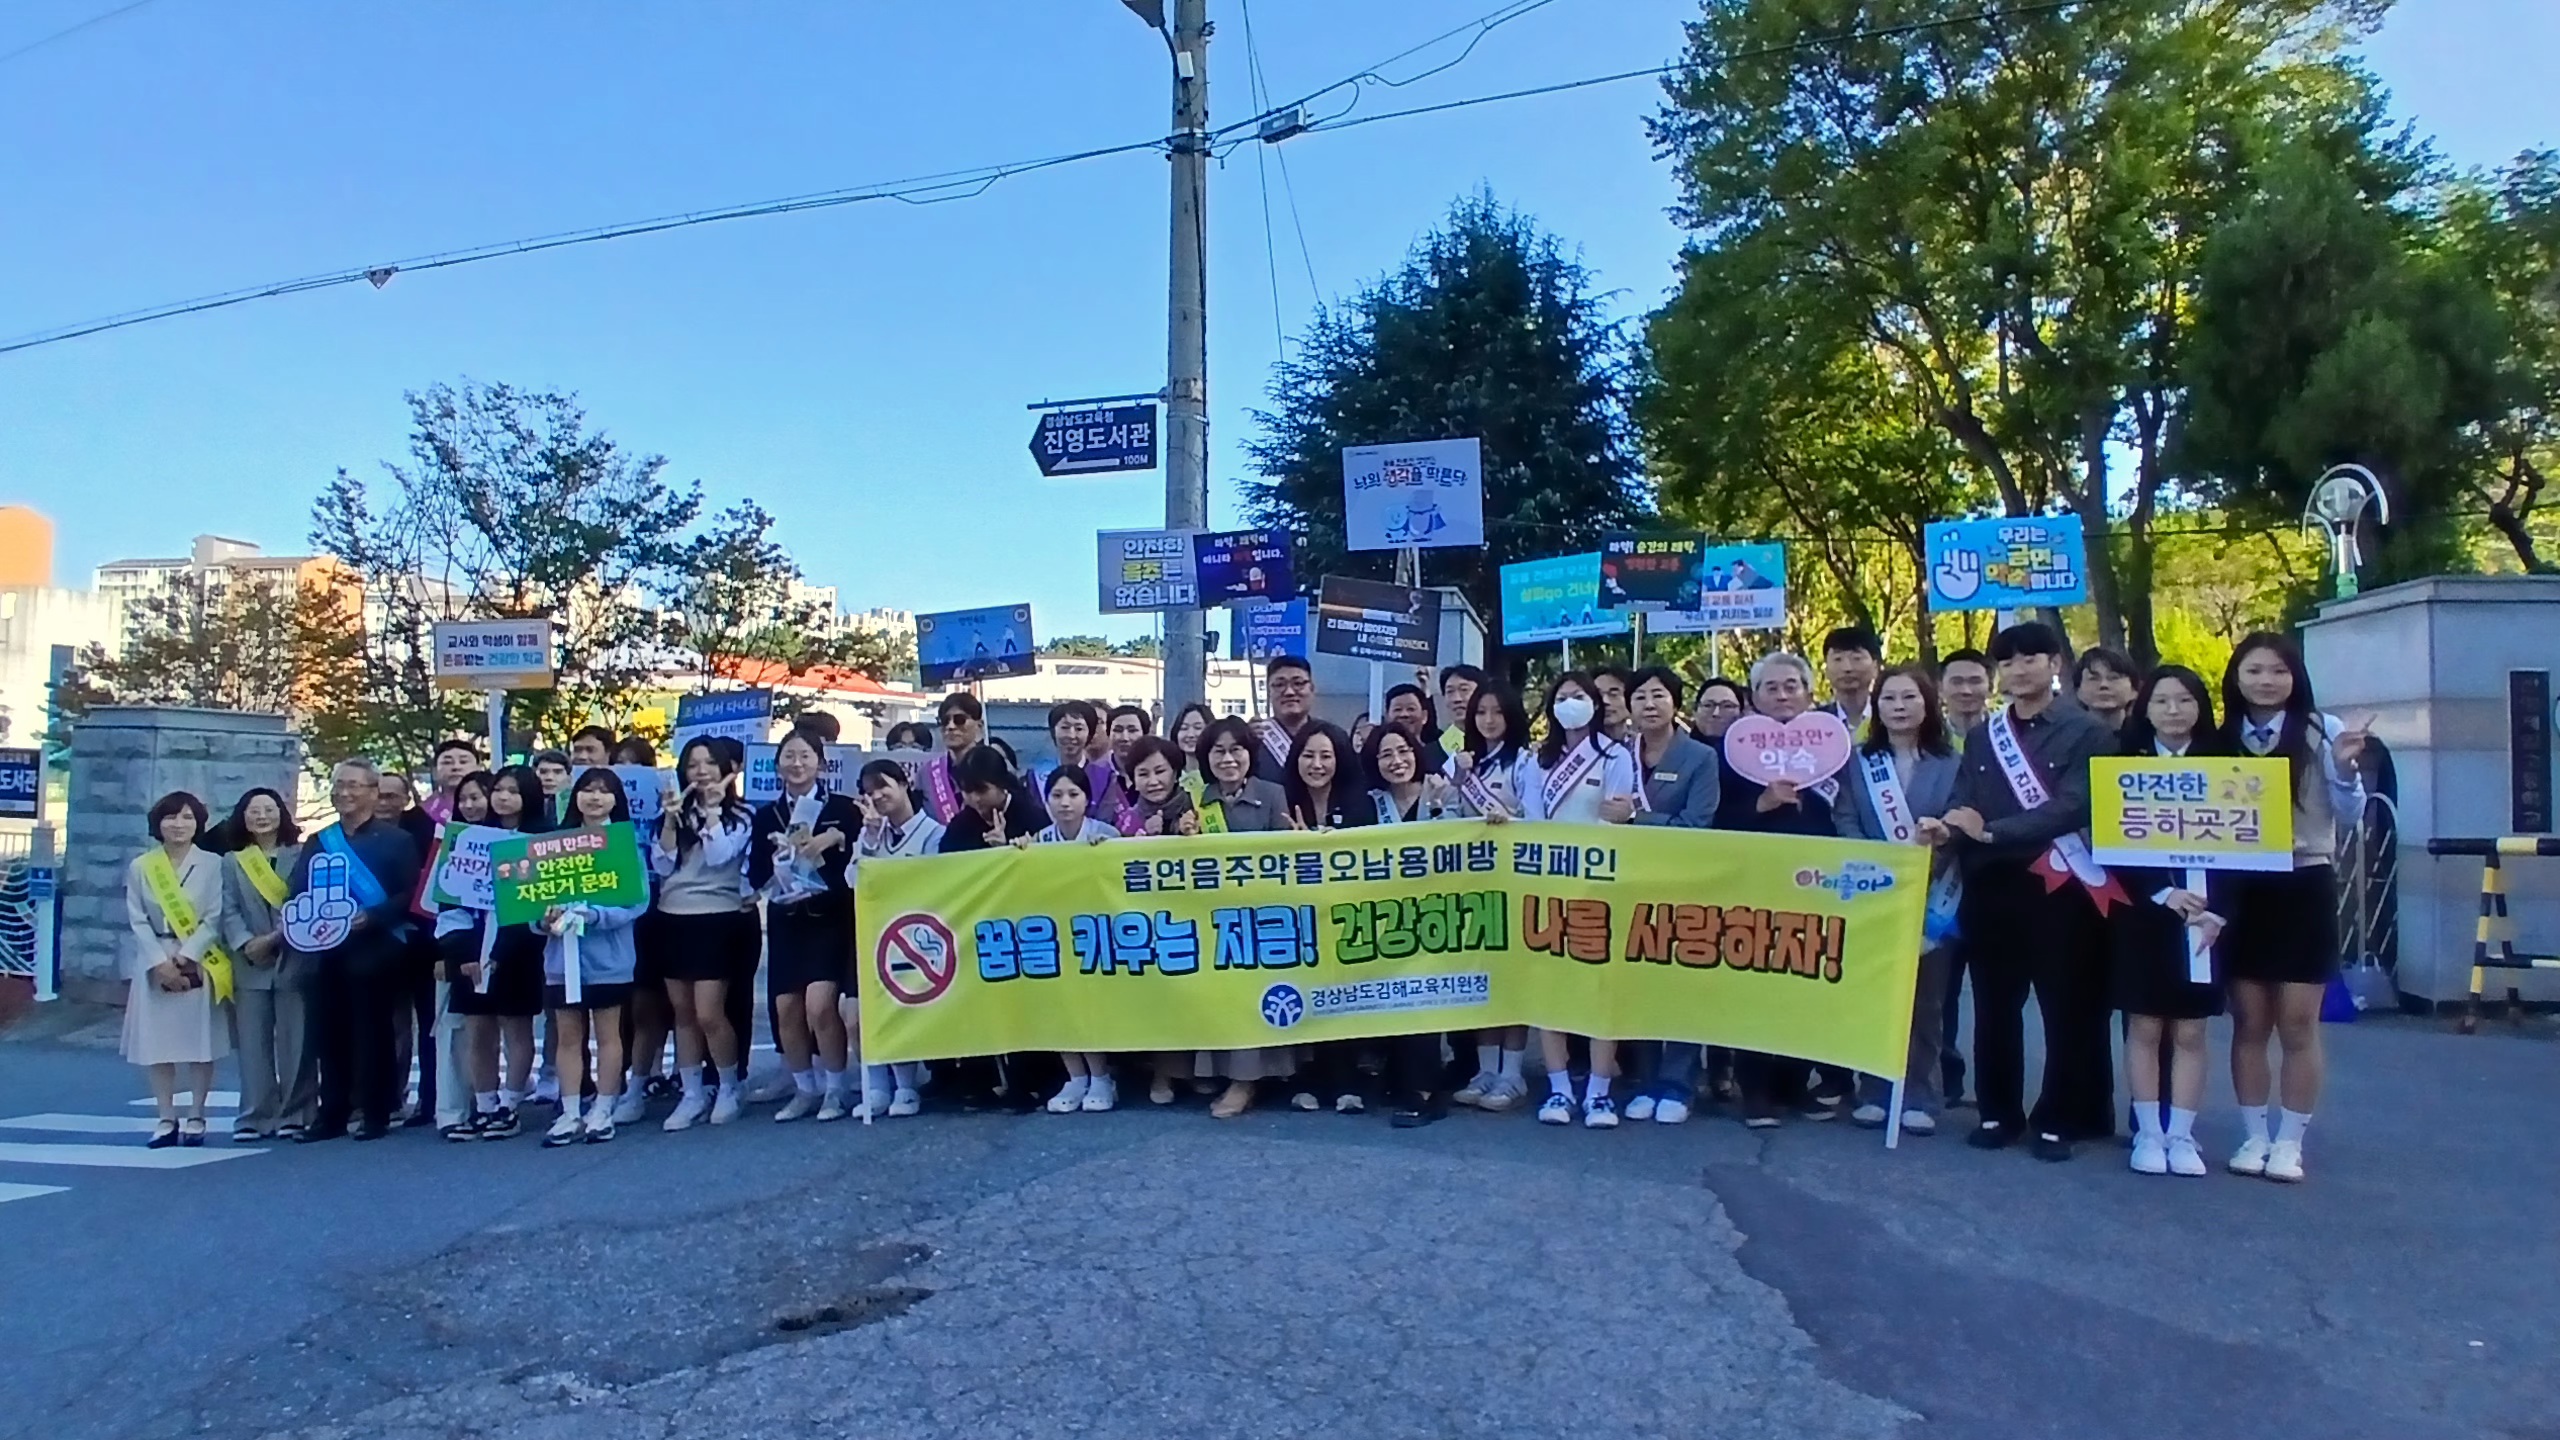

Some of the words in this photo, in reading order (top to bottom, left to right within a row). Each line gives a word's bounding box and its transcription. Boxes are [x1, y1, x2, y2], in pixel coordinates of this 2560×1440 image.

[1043, 422, 1151, 454] 진영도서관
[1998, 526, 2048, 543] 우리는
[1123, 536, 1185, 561] 안전한
[1121, 561, 1184, 585] 음주는
[1115, 582, 1197, 608] 없습니다
[447, 634, 479, 648] 교사와
[1750, 728, 1823, 750] 평생금연
[1759, 747, 1818, 775] 약속
[2117, 772, 2208, 802] 안전한
[2118, 806, 2260, 843] 등하굣길
[533, 840, 561, 856] 함께
[563, 834, 604, 852] 만드는
[536, 853, 595, 879] 안전한
[1123, 840, 1498, 893] 흡연음주약물오남용예방
[1513, 842, 1616, 881] 캠페인
[516, 877, 576, 902] 자전거
[579, 871, 619, 894] 문화
[975, 915, 1061, 983] 꿈을
[1070, 910, 1200, 977] 키우는
[1211, 904, 1320, 971] 지금!
[1330, 890, 1508, 961] 건강하게
[1522, 894, 1612, 965] 나를
[1625, 901, 1847, 984] 사랑하자!
[1311, 973, 1489, 1008] 경상남도김해교육지원청
